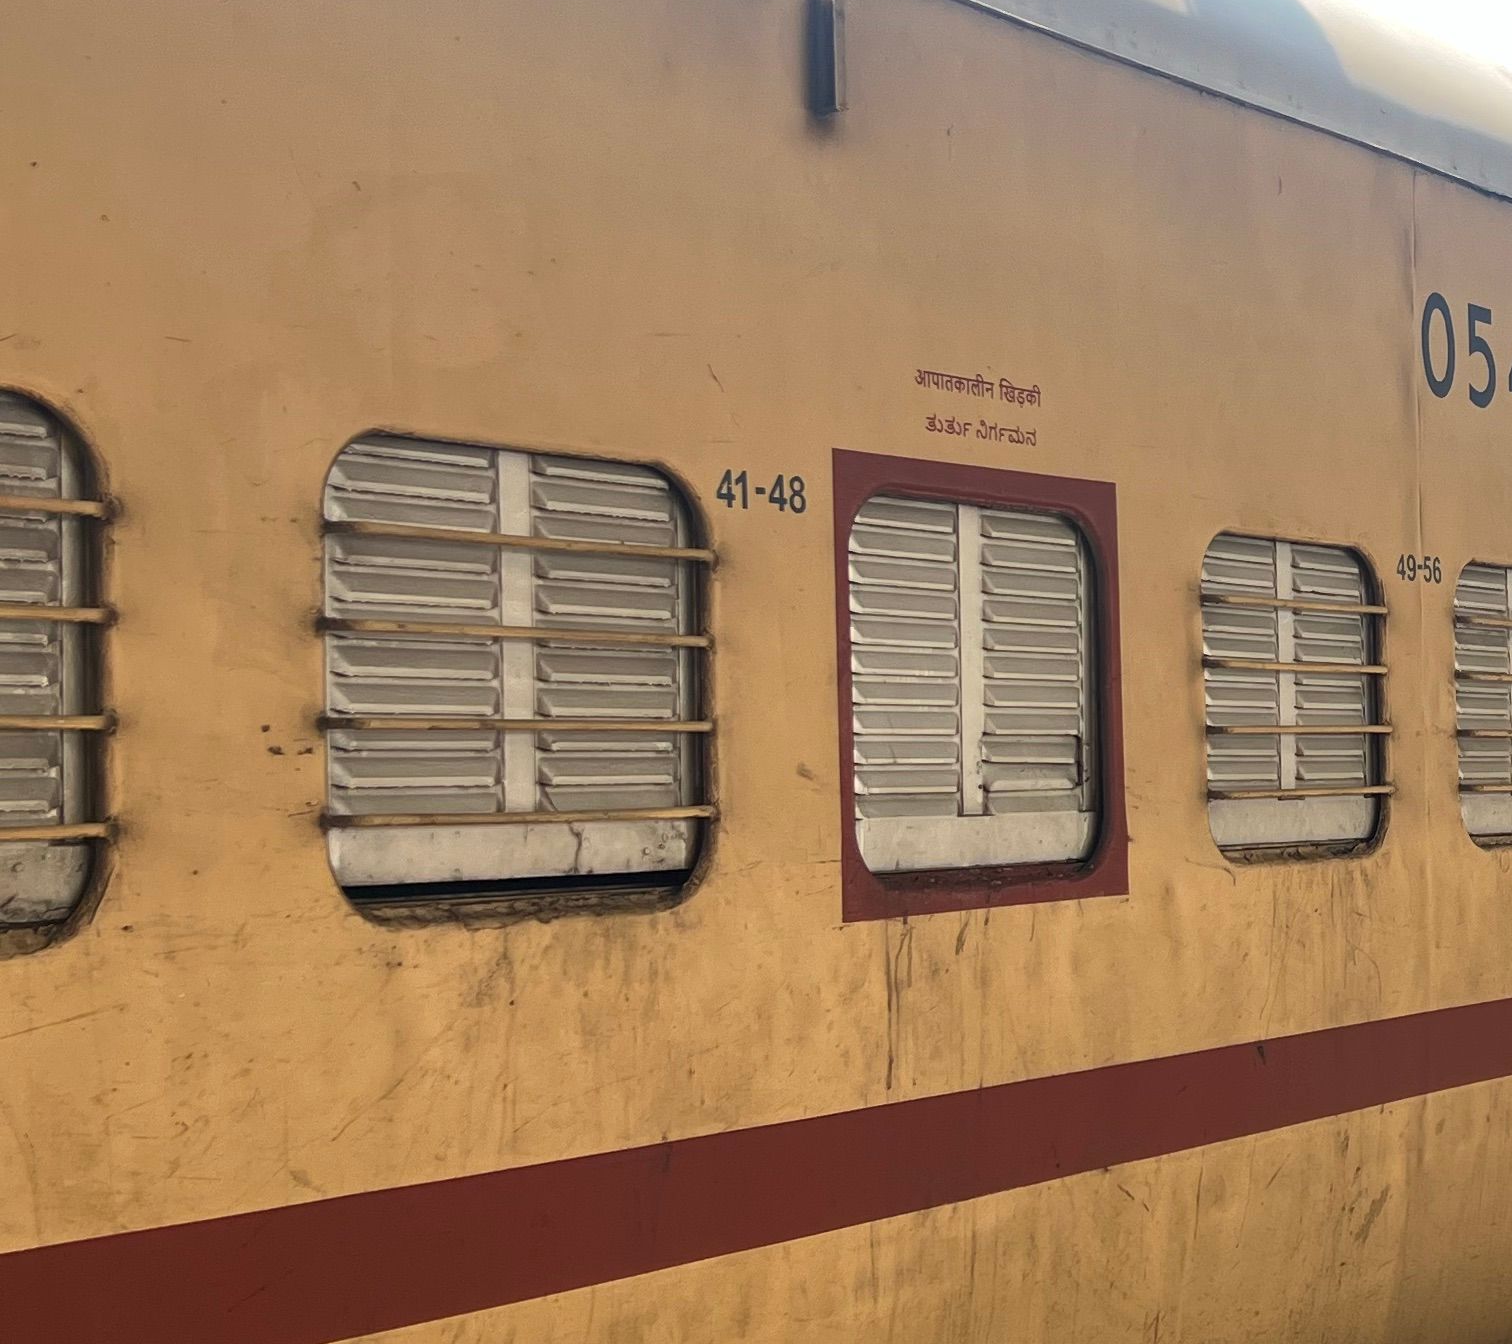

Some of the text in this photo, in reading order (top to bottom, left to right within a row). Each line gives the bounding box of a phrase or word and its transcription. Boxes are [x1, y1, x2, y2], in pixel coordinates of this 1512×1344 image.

[914, 368, 1042, 408] आपातकालीन खिड़की
[715, 468, 807, 514] 41-48
[1396, 553, 1442, 585] 49-56
